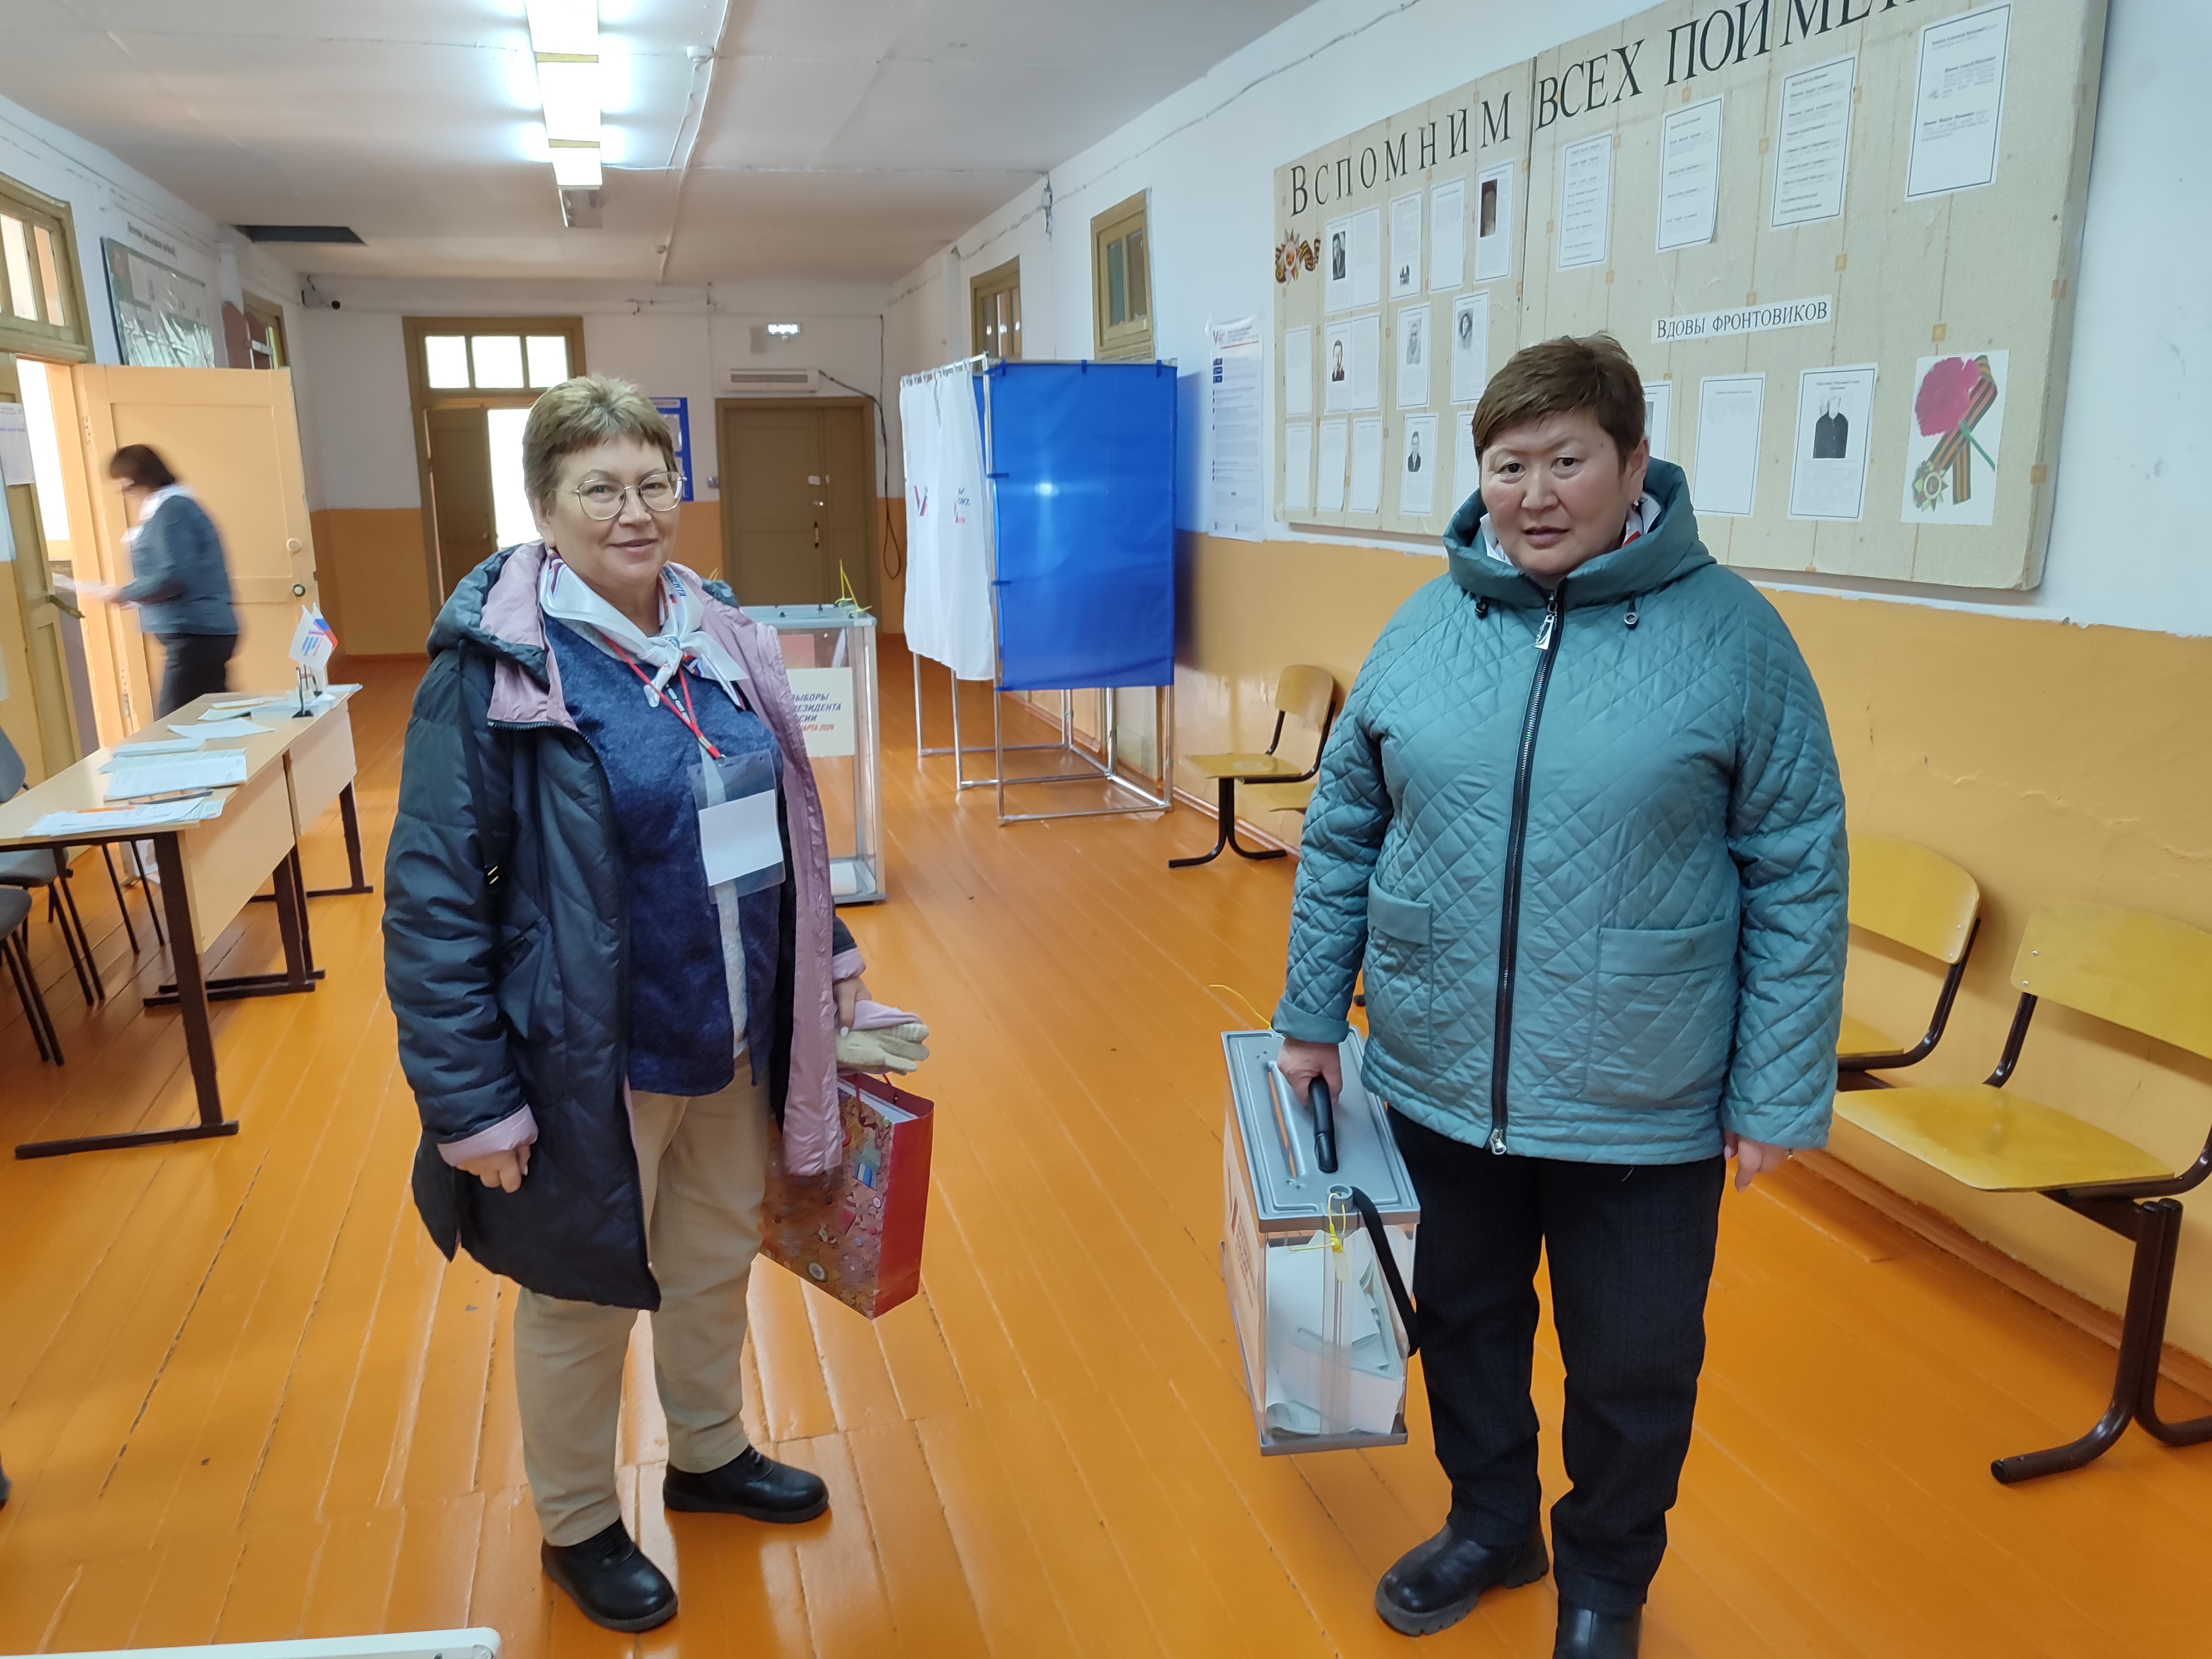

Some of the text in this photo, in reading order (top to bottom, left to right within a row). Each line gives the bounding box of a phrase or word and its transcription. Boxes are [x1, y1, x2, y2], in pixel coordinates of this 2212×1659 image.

[1291, 91, 1511, 217] ВСПОМНИМ
[1535, 39, 1646, 132] ВСЕХ
[1657, 301, 1828, 341] ВДОВЫ ФРОНТОВИКОВ
[796, 702, 842, 713] ЕЗИДЕНТА
